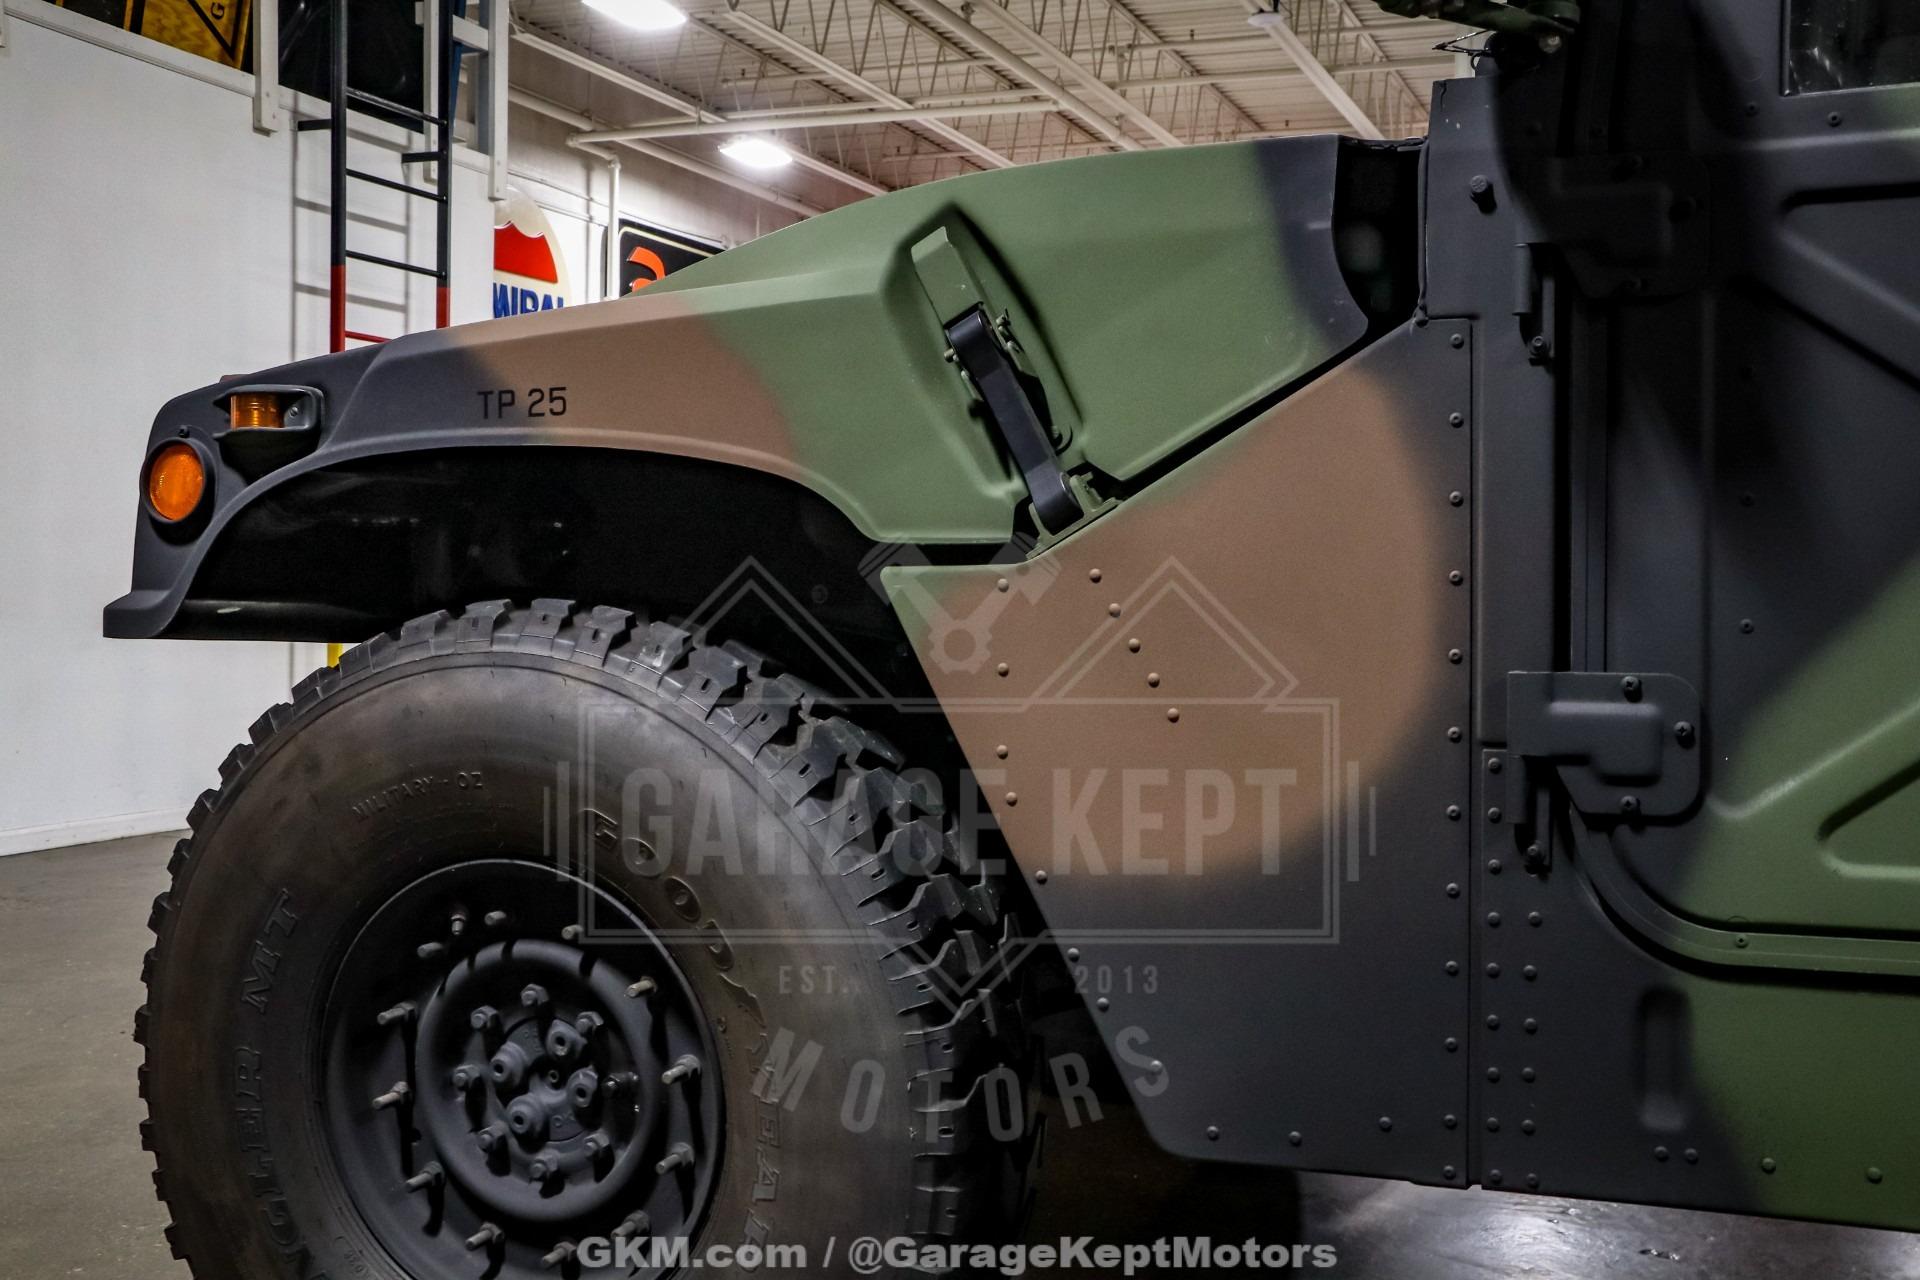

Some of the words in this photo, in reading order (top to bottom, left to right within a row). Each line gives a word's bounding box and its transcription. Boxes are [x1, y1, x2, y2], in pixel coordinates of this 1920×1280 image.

[477, 390, 515, 419] TP
[528, 387, 567, 418] 25
[241, 886, 300, 1016] MT
